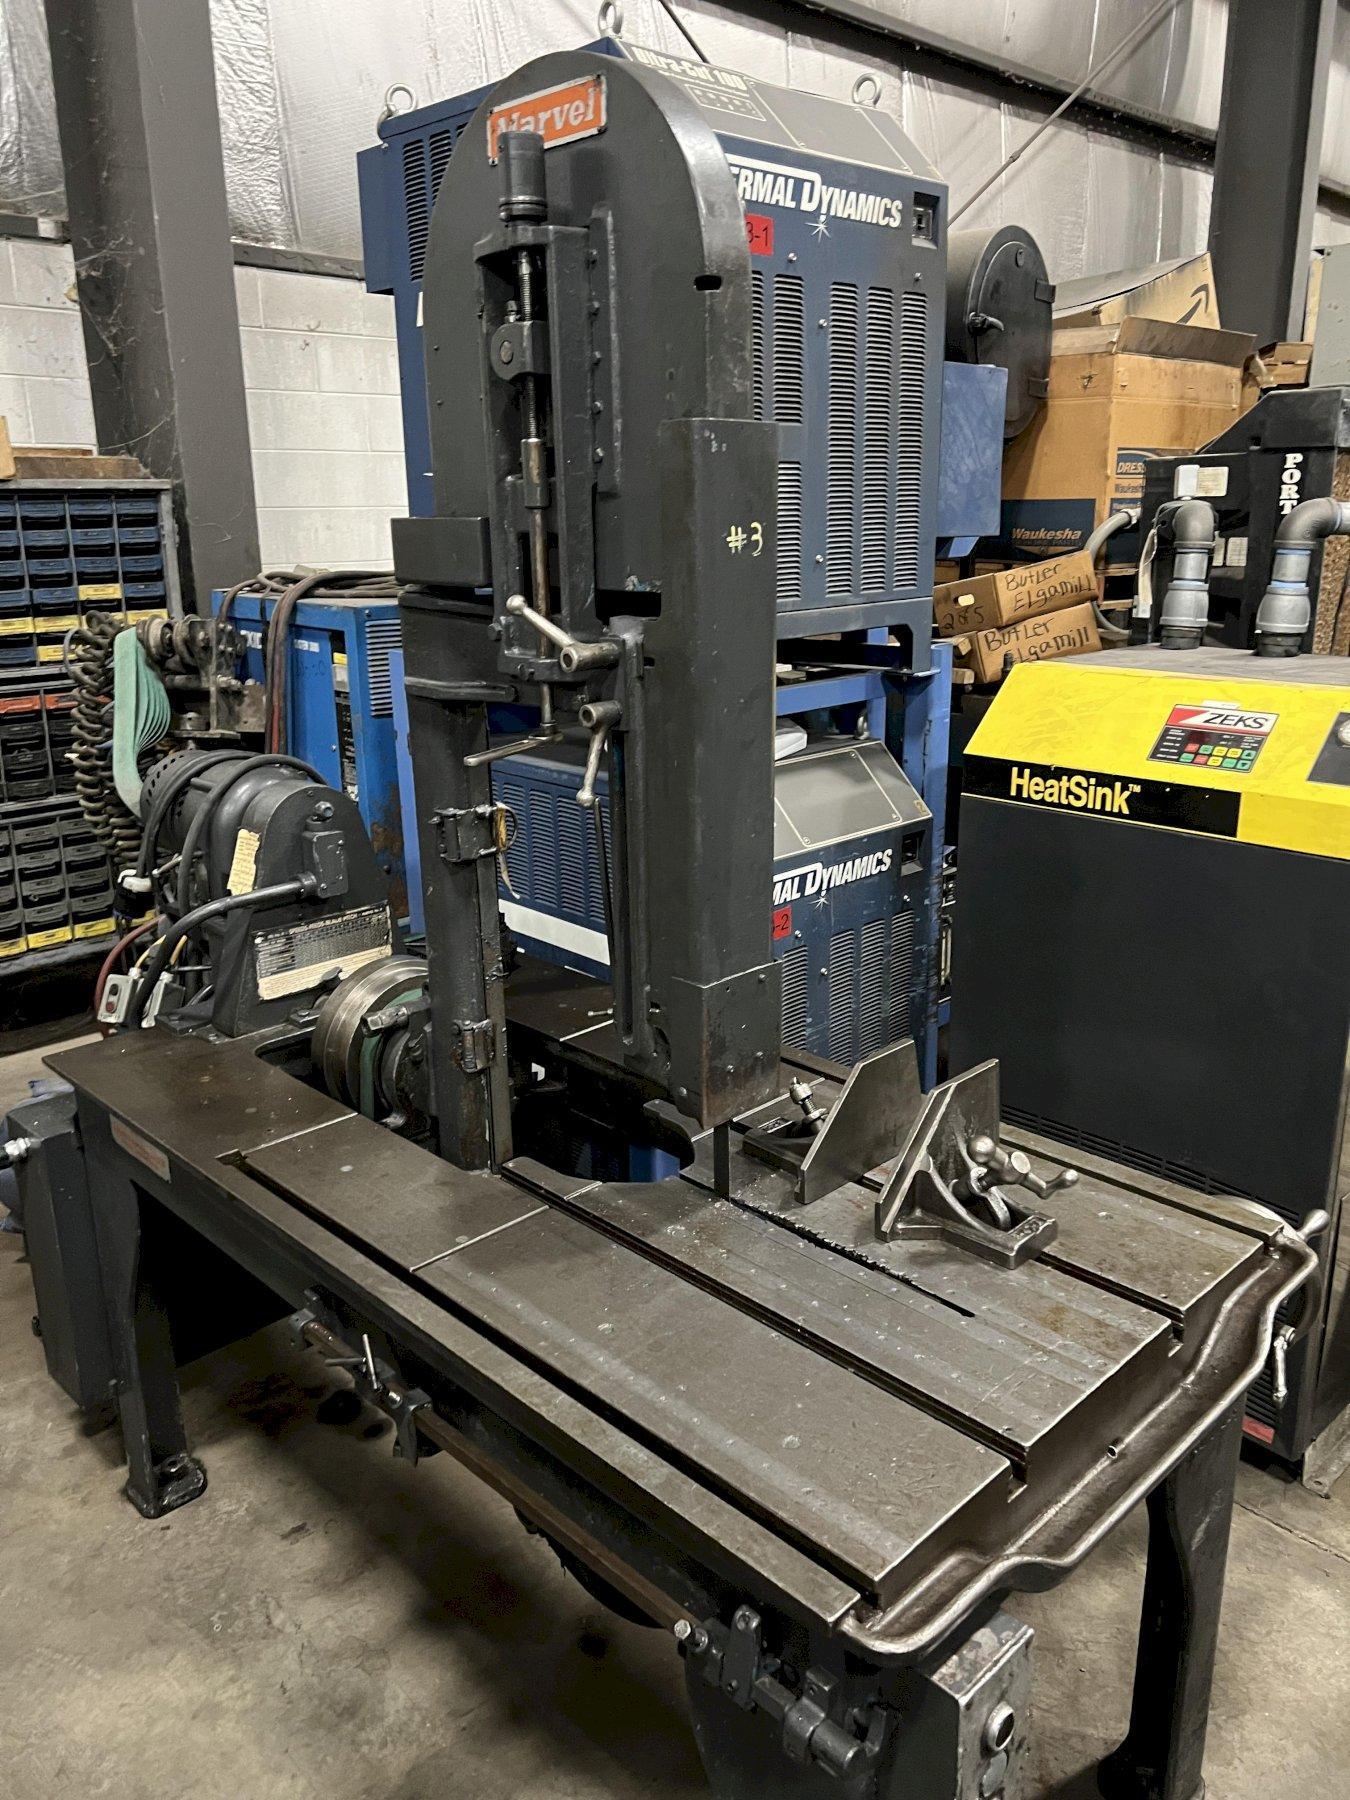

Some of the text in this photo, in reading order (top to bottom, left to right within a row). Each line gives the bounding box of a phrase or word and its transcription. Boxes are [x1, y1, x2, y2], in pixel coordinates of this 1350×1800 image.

[800, 171, 903, 229] DYNAMICS
[726, 521, 764, 557] #3
[1012, 528, 1083, 541] Waukesha
[942, 612, 955, 630] 2
[1202, 712, 1269, 730] ZEKS
[804, 848, 893, 897] DYNAMICS
